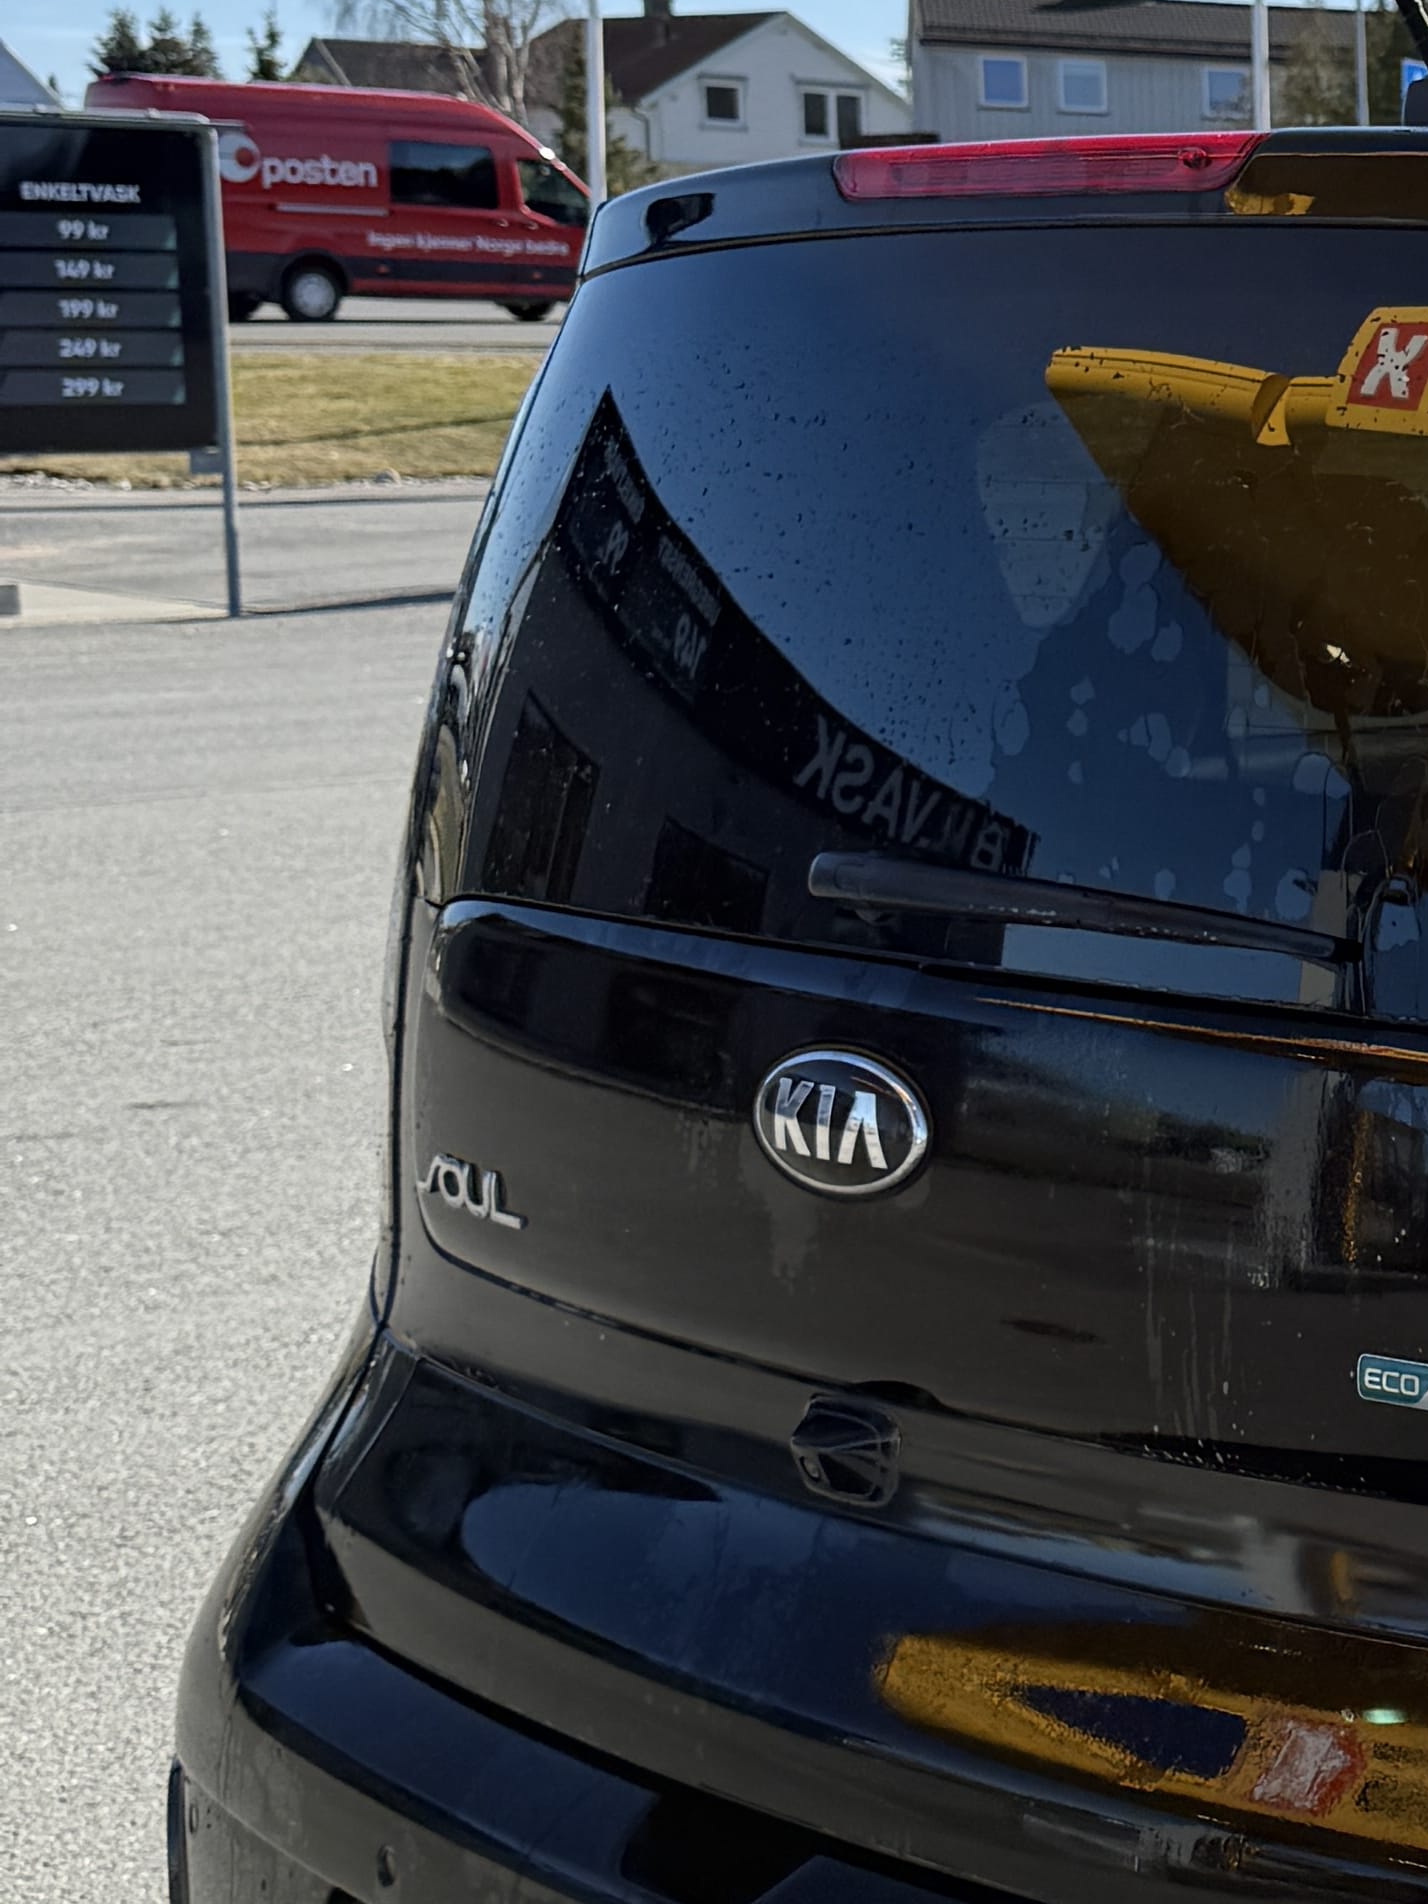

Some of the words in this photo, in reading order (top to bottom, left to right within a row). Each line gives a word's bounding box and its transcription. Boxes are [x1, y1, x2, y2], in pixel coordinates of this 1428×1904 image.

[262, 154, 378, 188] posten
[20, 181, 141, 203] ENKELTVASK
[57, 219, 85, 240] 99
[87, 220, 110, 240] kr
[92, 259, 115, 279] kr
[58, 299, 93, 319] 199
[96, 300, 119, 319] kr
[58, 338, 96, 358] 249
[100, 338, 122, 358] kr
[61, 377, 99, 397] 299
[102, 378, 124, 397] kr
[773, 1076, 888, 1170] KIA
[417, 1153, 528, 1230] SOUL
[1364, 1367, 1420, 1396] ECO
